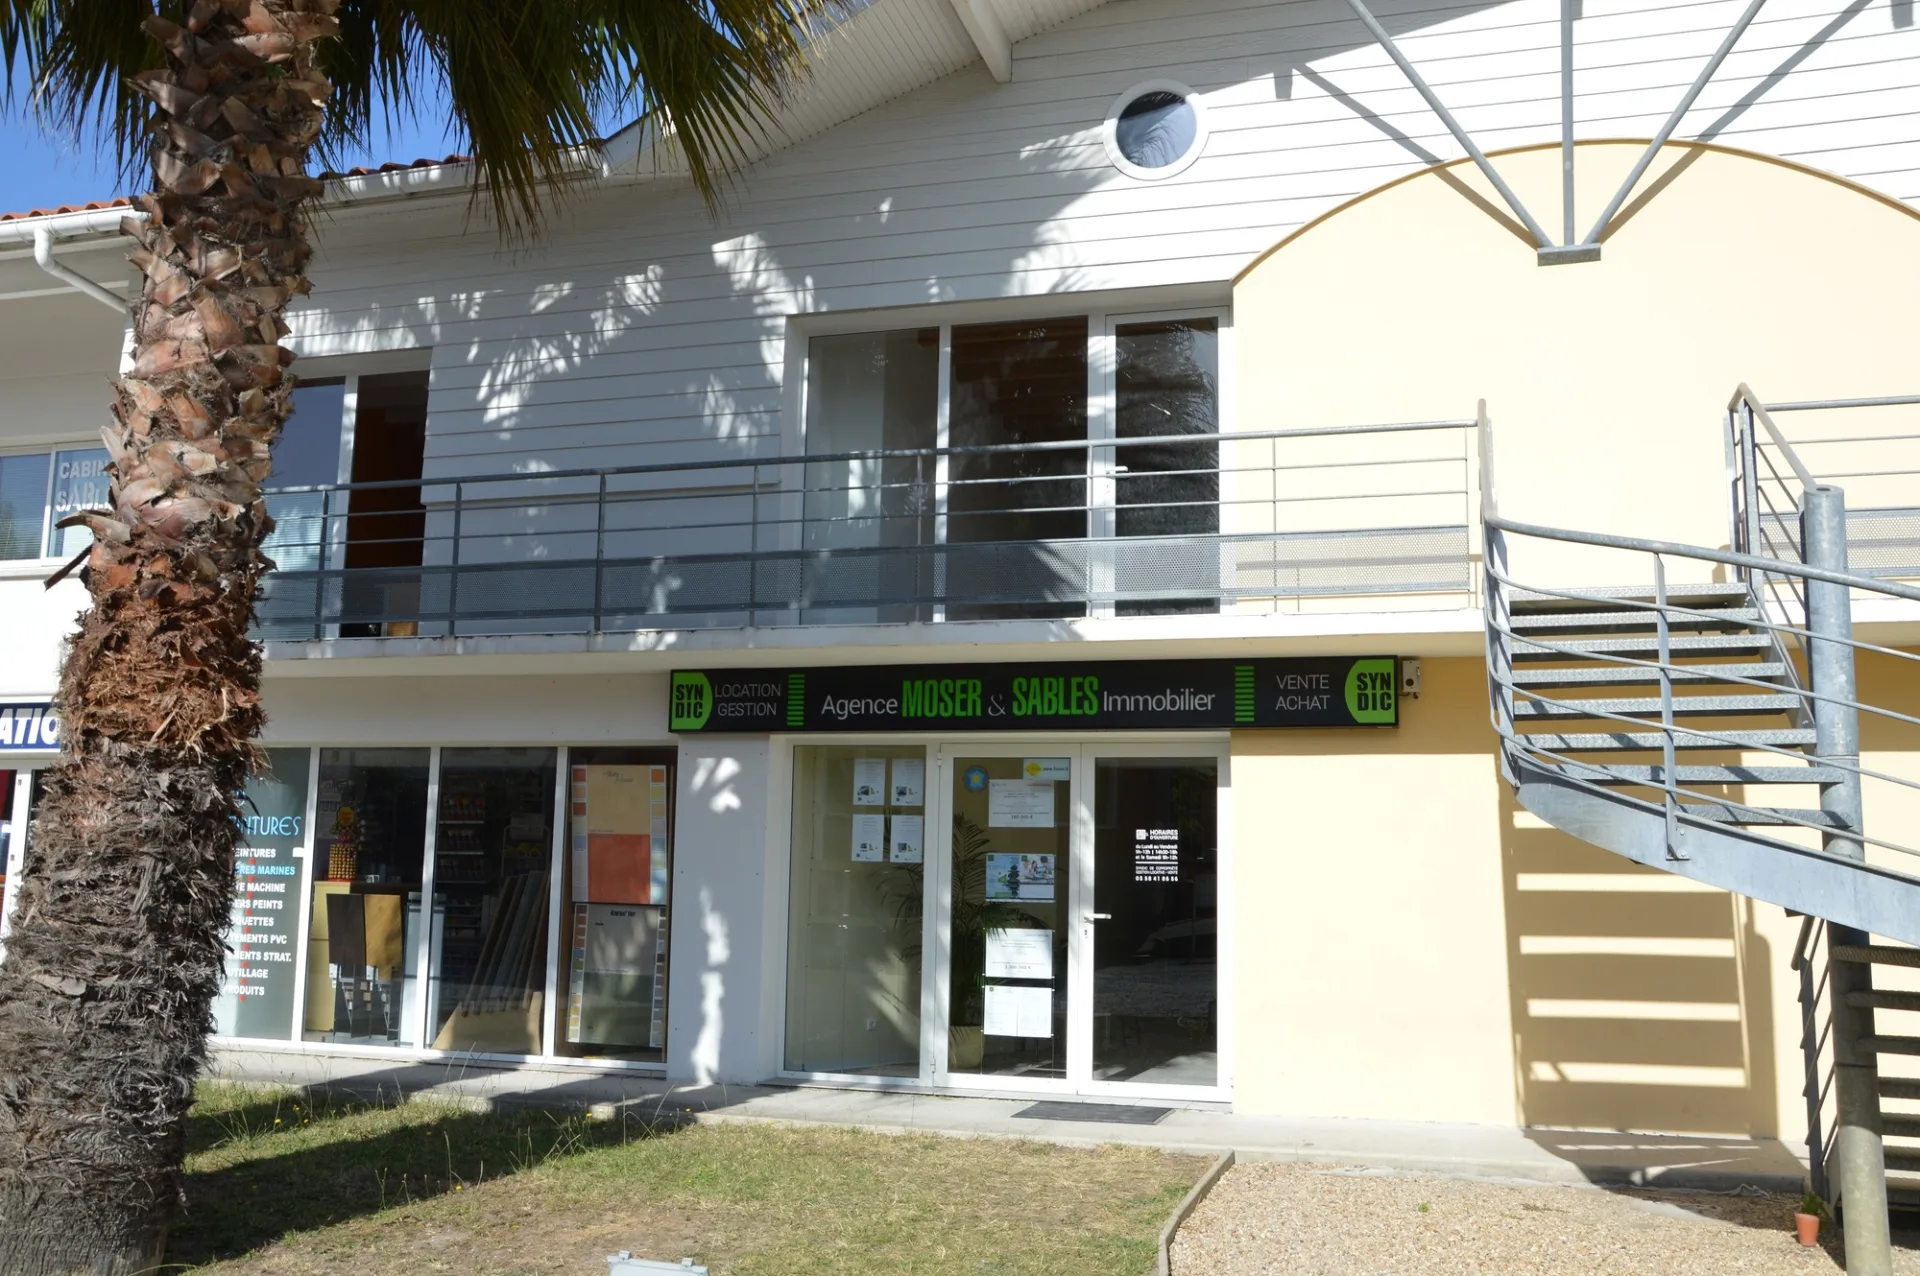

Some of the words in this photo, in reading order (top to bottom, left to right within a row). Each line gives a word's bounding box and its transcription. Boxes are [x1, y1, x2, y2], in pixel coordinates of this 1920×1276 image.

[59, 459, 109, 479] CABIN
[1276, 674, 1330, 690] VENTE
[1356, 672, 1392, 691] SYN
[675, 683, 704, 701] SYN
[714, 683, 782, 698] LOCATION
[821, 695, 898, 720] Agence
[901, 679, 982, 717] MOSER
[988, 693, 1006, 716] &
[1012, 675, 1099, 716] SABLES
[1103, 688, 1215, 712] Immobilier
[1275, 695, 1330, 711] ACHAT
[1357, 691, 1392, 711] DIC
[675, 701, 703, 719] DIC
[717, 702, 777, 716] GESTION
[229, 815, 302, 836] NTURES
[233, 847, 276, 858] EINTURES
[257, 865, 296, 876] MARINES
[247, 882, 286, 893] MACHINE
[233, 899, 251, 909] ERS
[252, 899, 284, 910] PEINTS
[226, 933, 268, 944] TEMENTS
[270, 934, 287, 945] PVC
[263, 952, 292, 962] STRAT.
[226, 967, 269, 979] UTILLAGE
